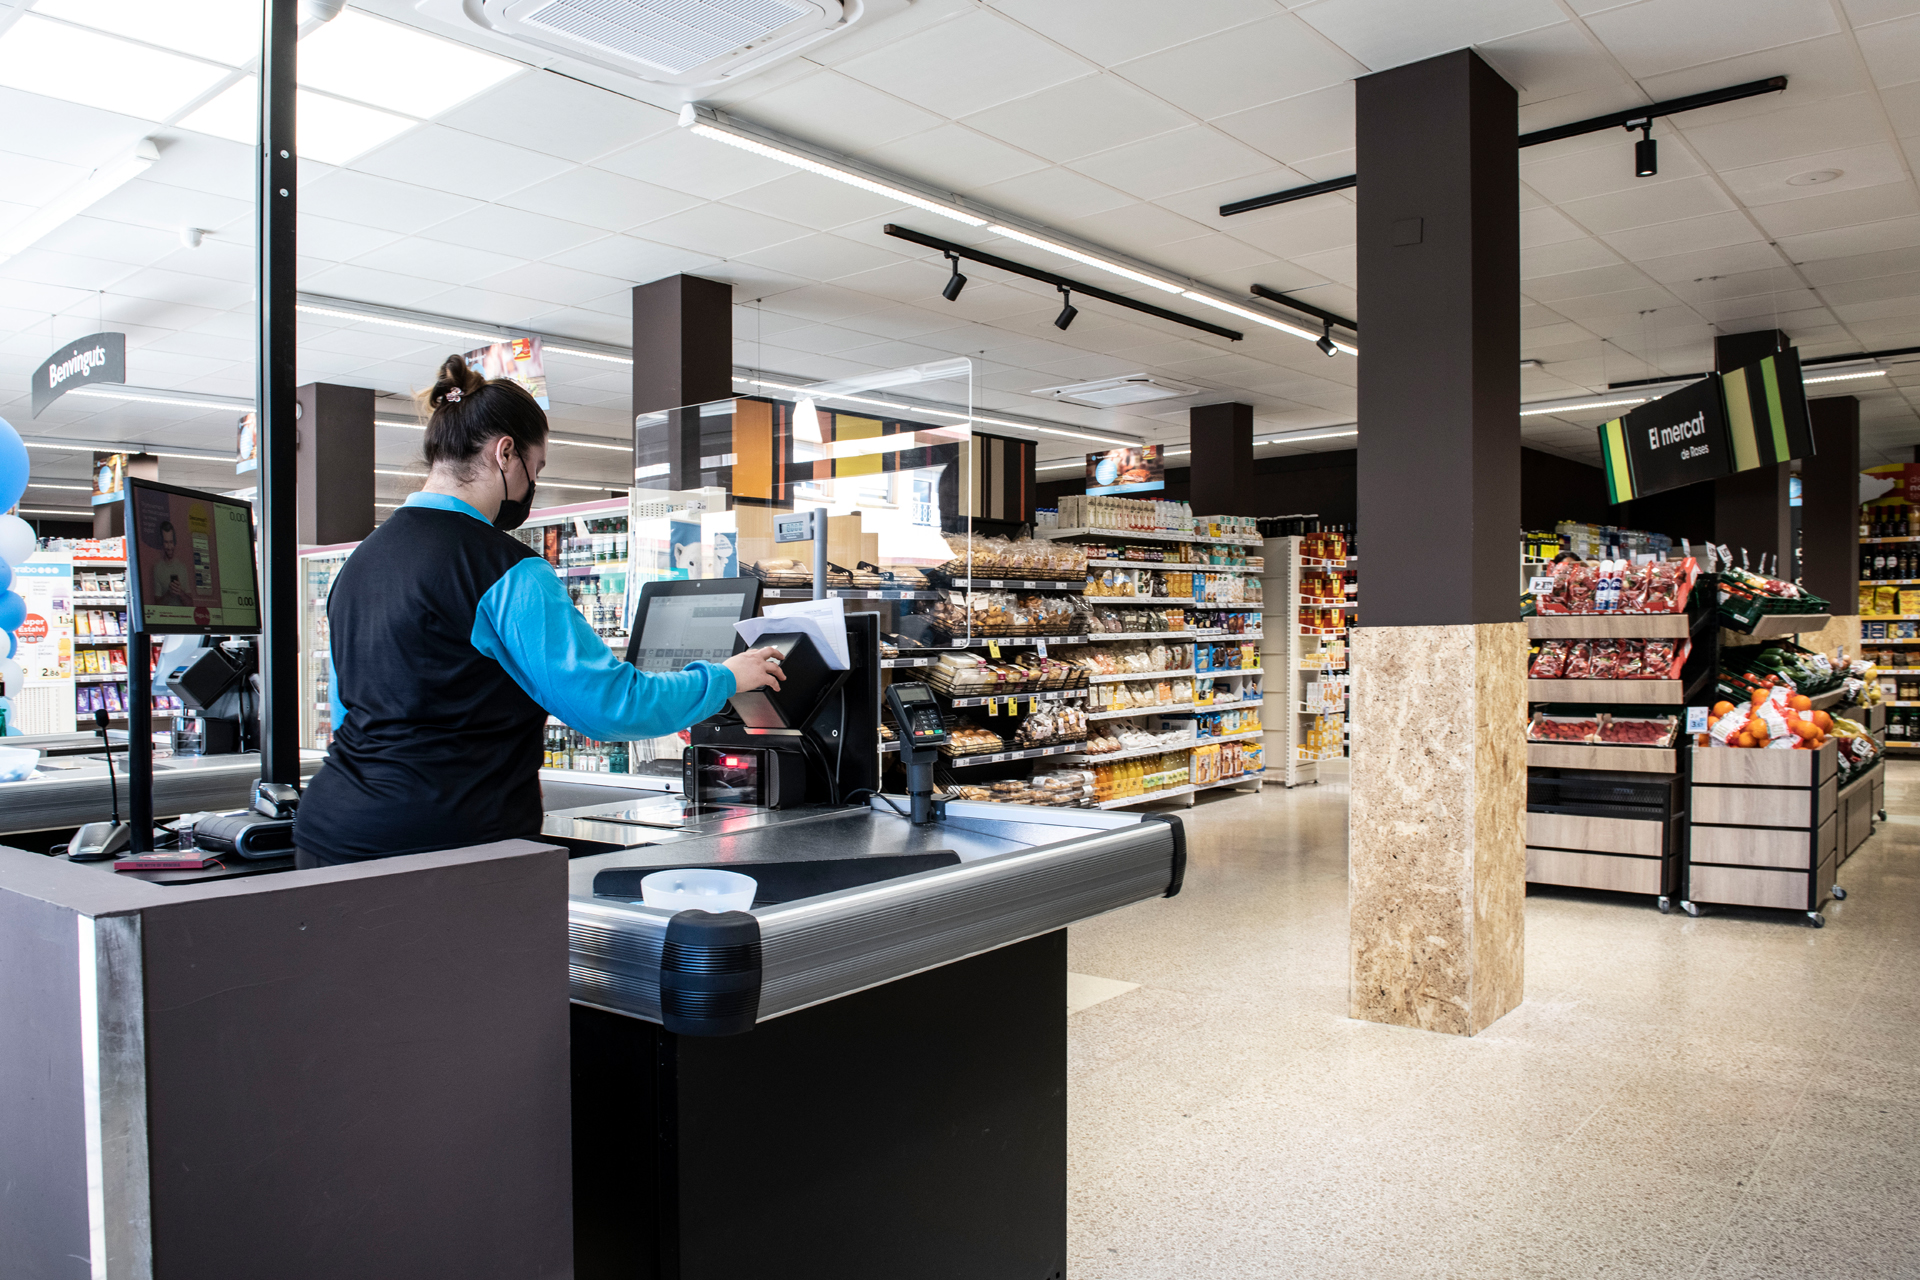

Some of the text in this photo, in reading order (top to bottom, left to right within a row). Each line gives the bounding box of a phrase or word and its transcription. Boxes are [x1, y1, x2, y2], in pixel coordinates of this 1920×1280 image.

[49, 345, 105, 389] Benvinguts
[1648, 411, 1706, 449] El mercat
[1681, 444, 1709, 460] de Roses
[18, 625, 46, 633] Estalvi
[23, 619, 45, 627] uper
